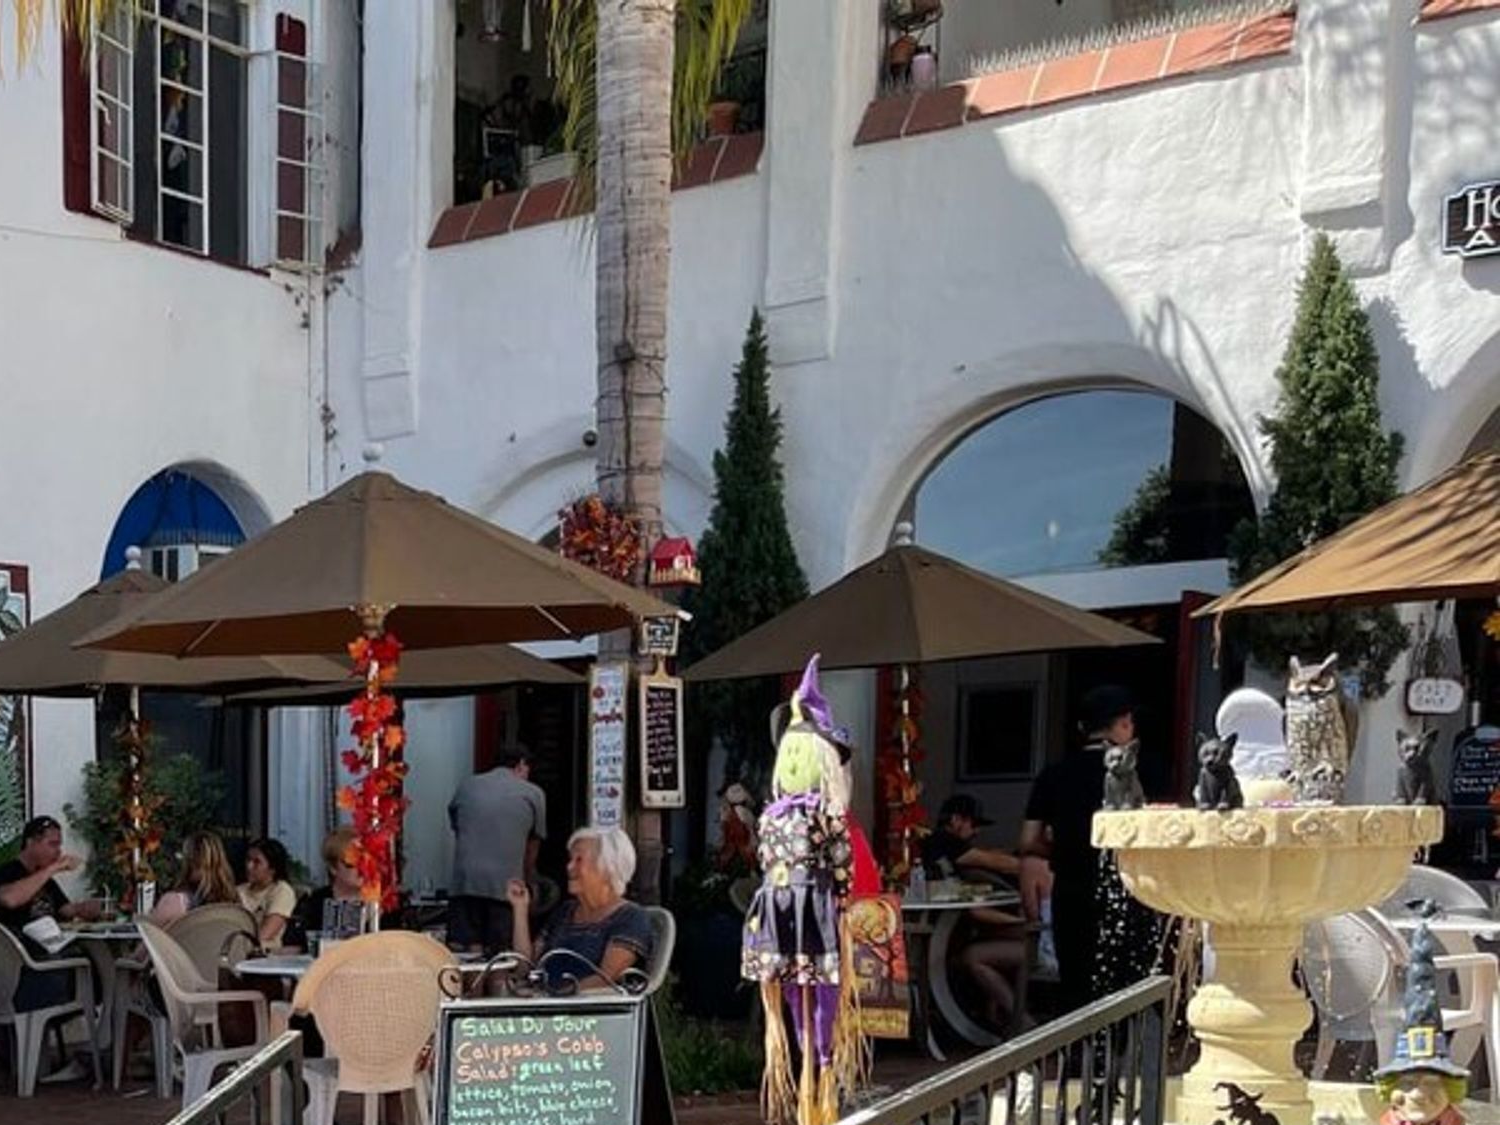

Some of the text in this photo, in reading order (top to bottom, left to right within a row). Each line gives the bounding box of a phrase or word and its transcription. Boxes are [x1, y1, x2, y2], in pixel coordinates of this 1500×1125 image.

[1463, 186, 1500, 232] H
[459, 1016, 598, 1037] Salad Du Jour
[456, 1034, 606, 1064] Calypso's Cobb
